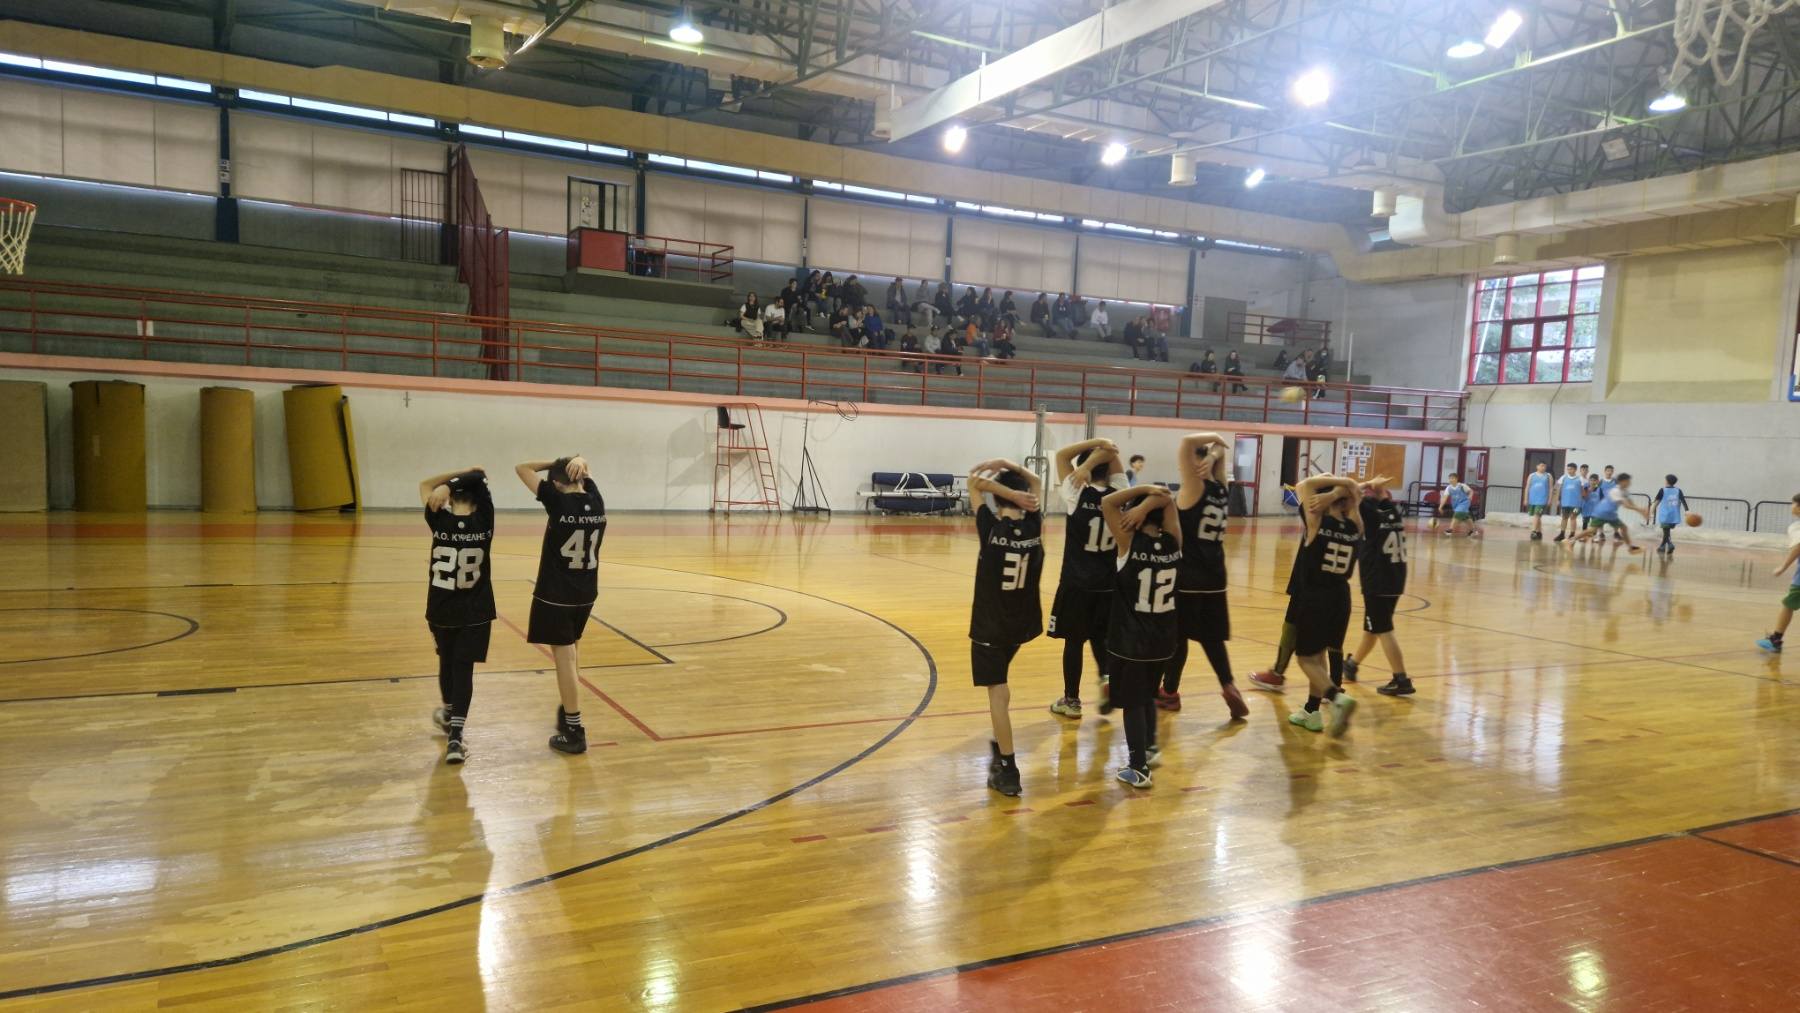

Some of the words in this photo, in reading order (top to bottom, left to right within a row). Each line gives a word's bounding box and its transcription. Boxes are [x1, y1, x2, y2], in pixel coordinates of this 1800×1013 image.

[433, 530, 450, 541] Α.Ο.
[560, 529, 600, 570] 41
[431, 545, 484, 590] 28
[1001, 552, 1030, 590] 31
[1321, 541, 1353, 574] 33
[1134, 567, 1177, 613] 12
